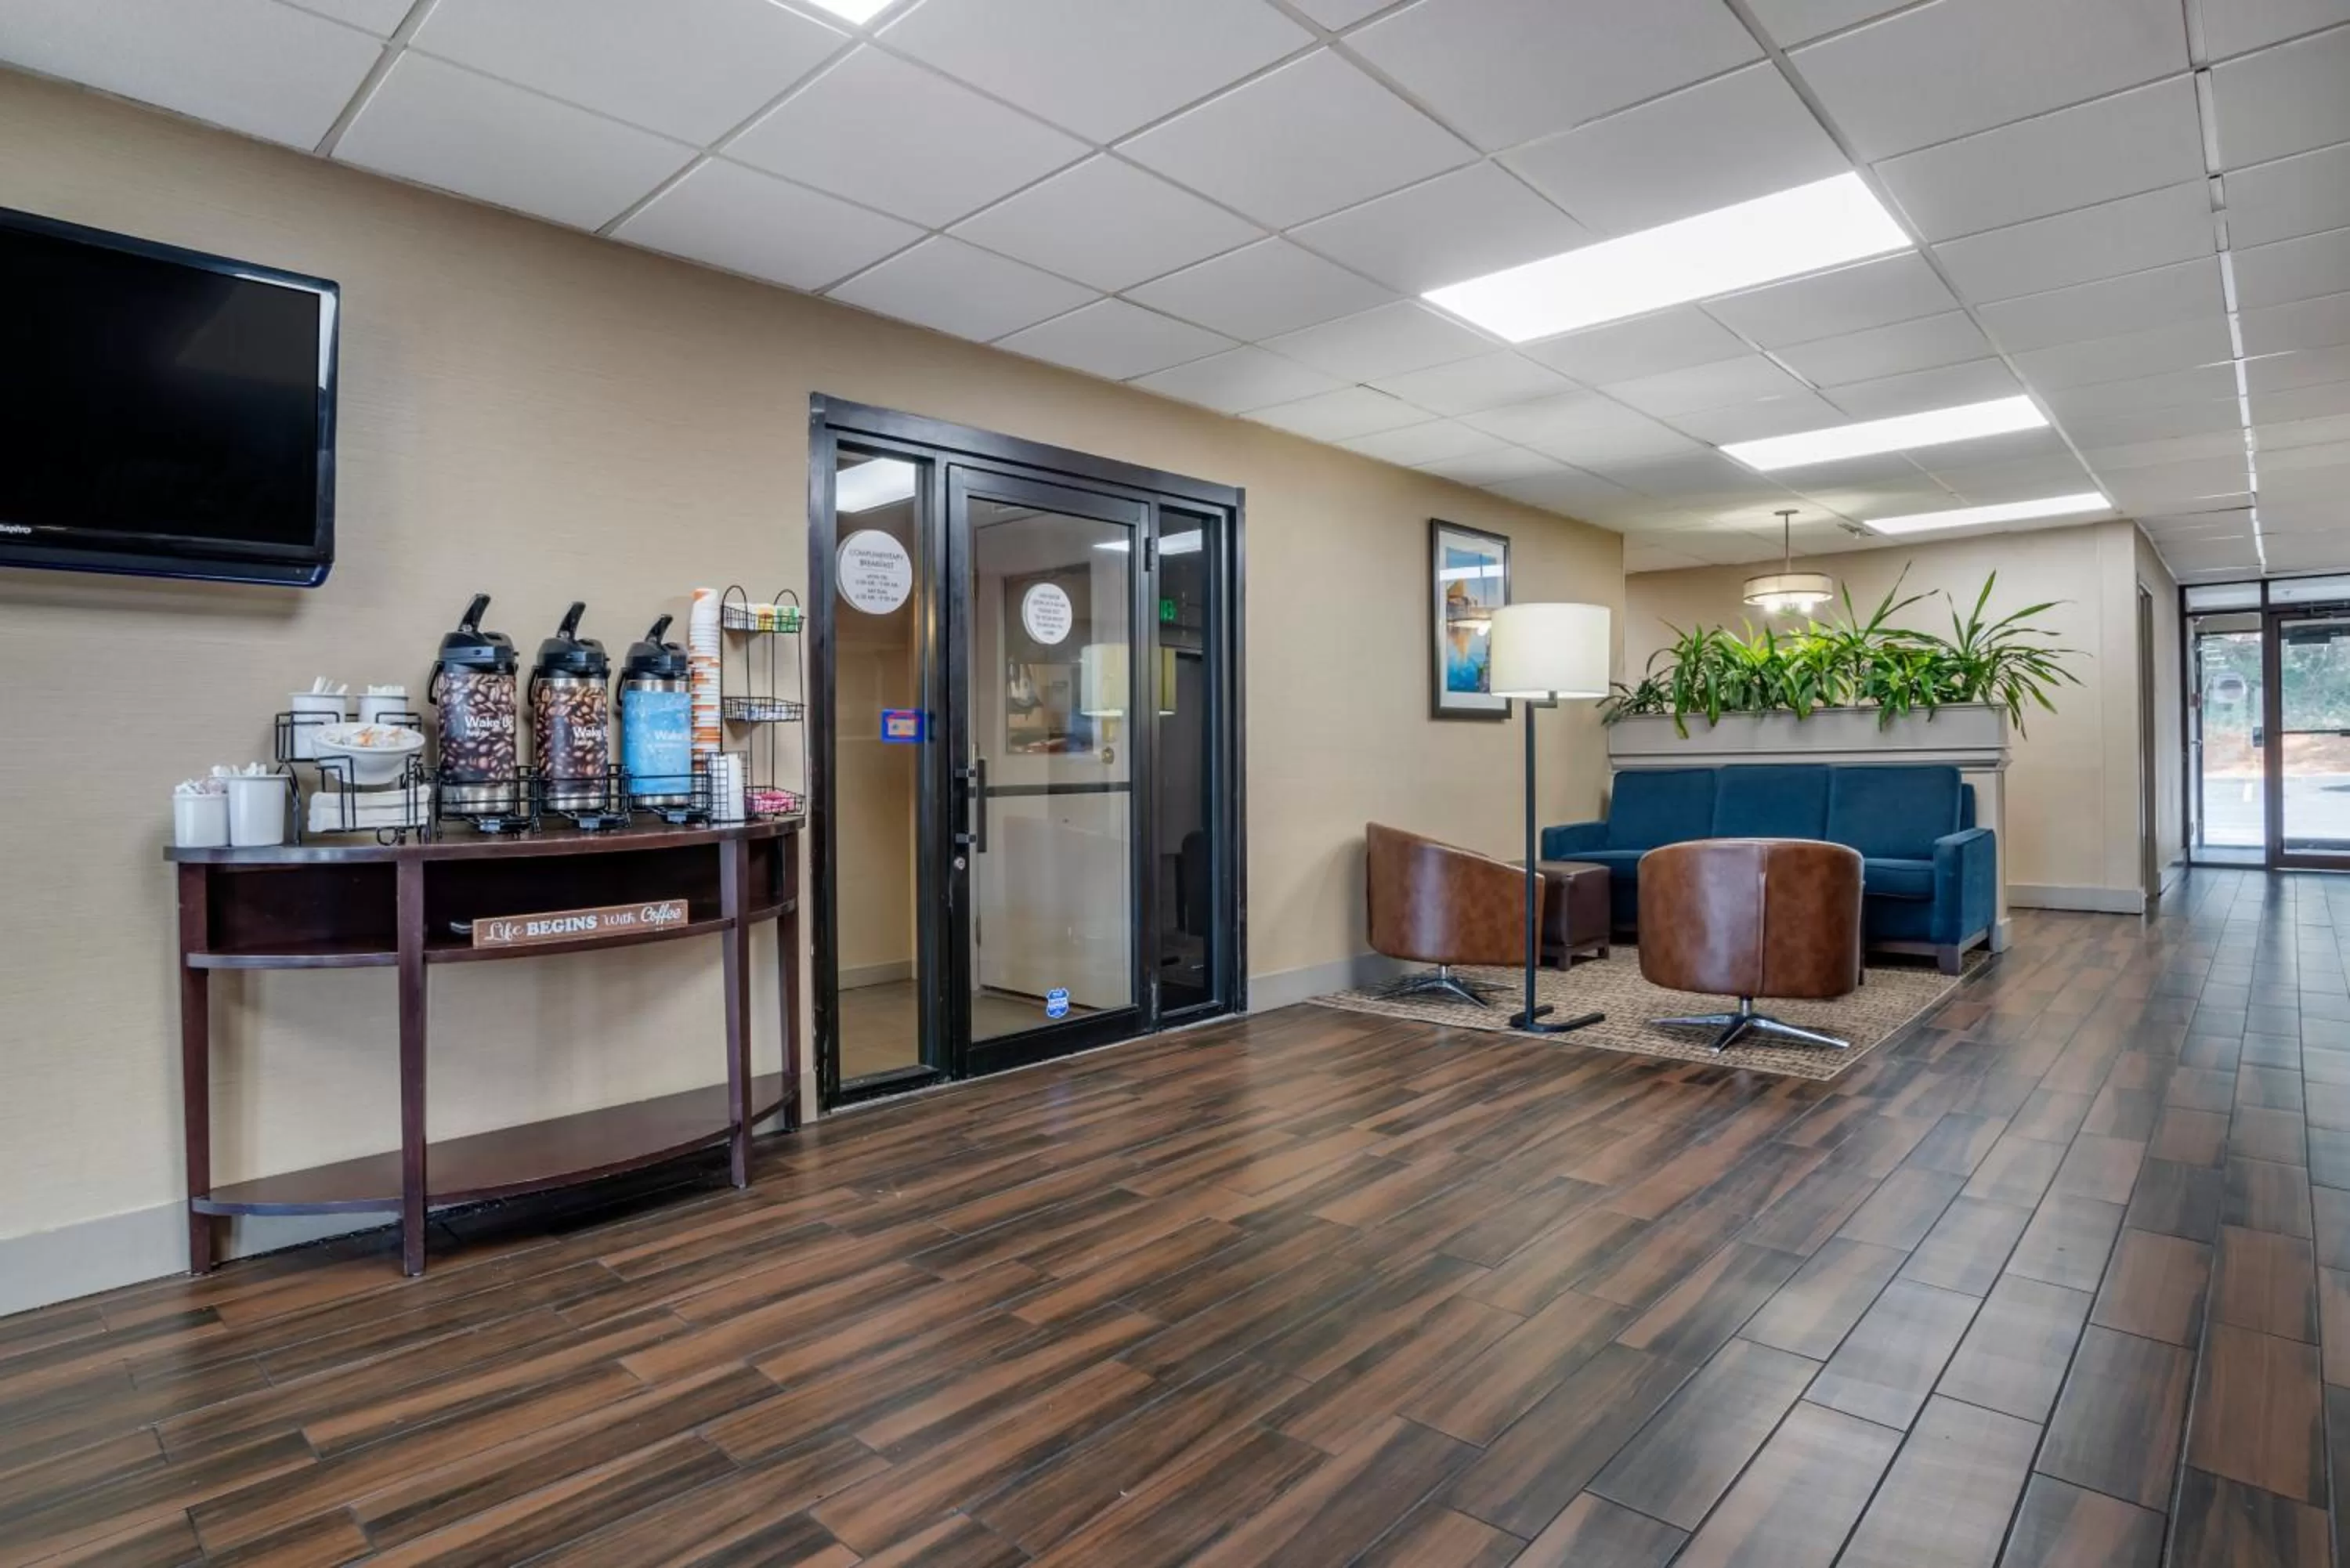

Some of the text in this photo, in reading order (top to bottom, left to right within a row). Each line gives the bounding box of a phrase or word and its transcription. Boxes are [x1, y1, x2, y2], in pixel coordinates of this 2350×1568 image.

[465, 715, 500, 728] Wake
[483, 921, 522, 941] Life
[526, 915, 598, 936] BEGINS
[640, 902, 683, 926] Coffee
